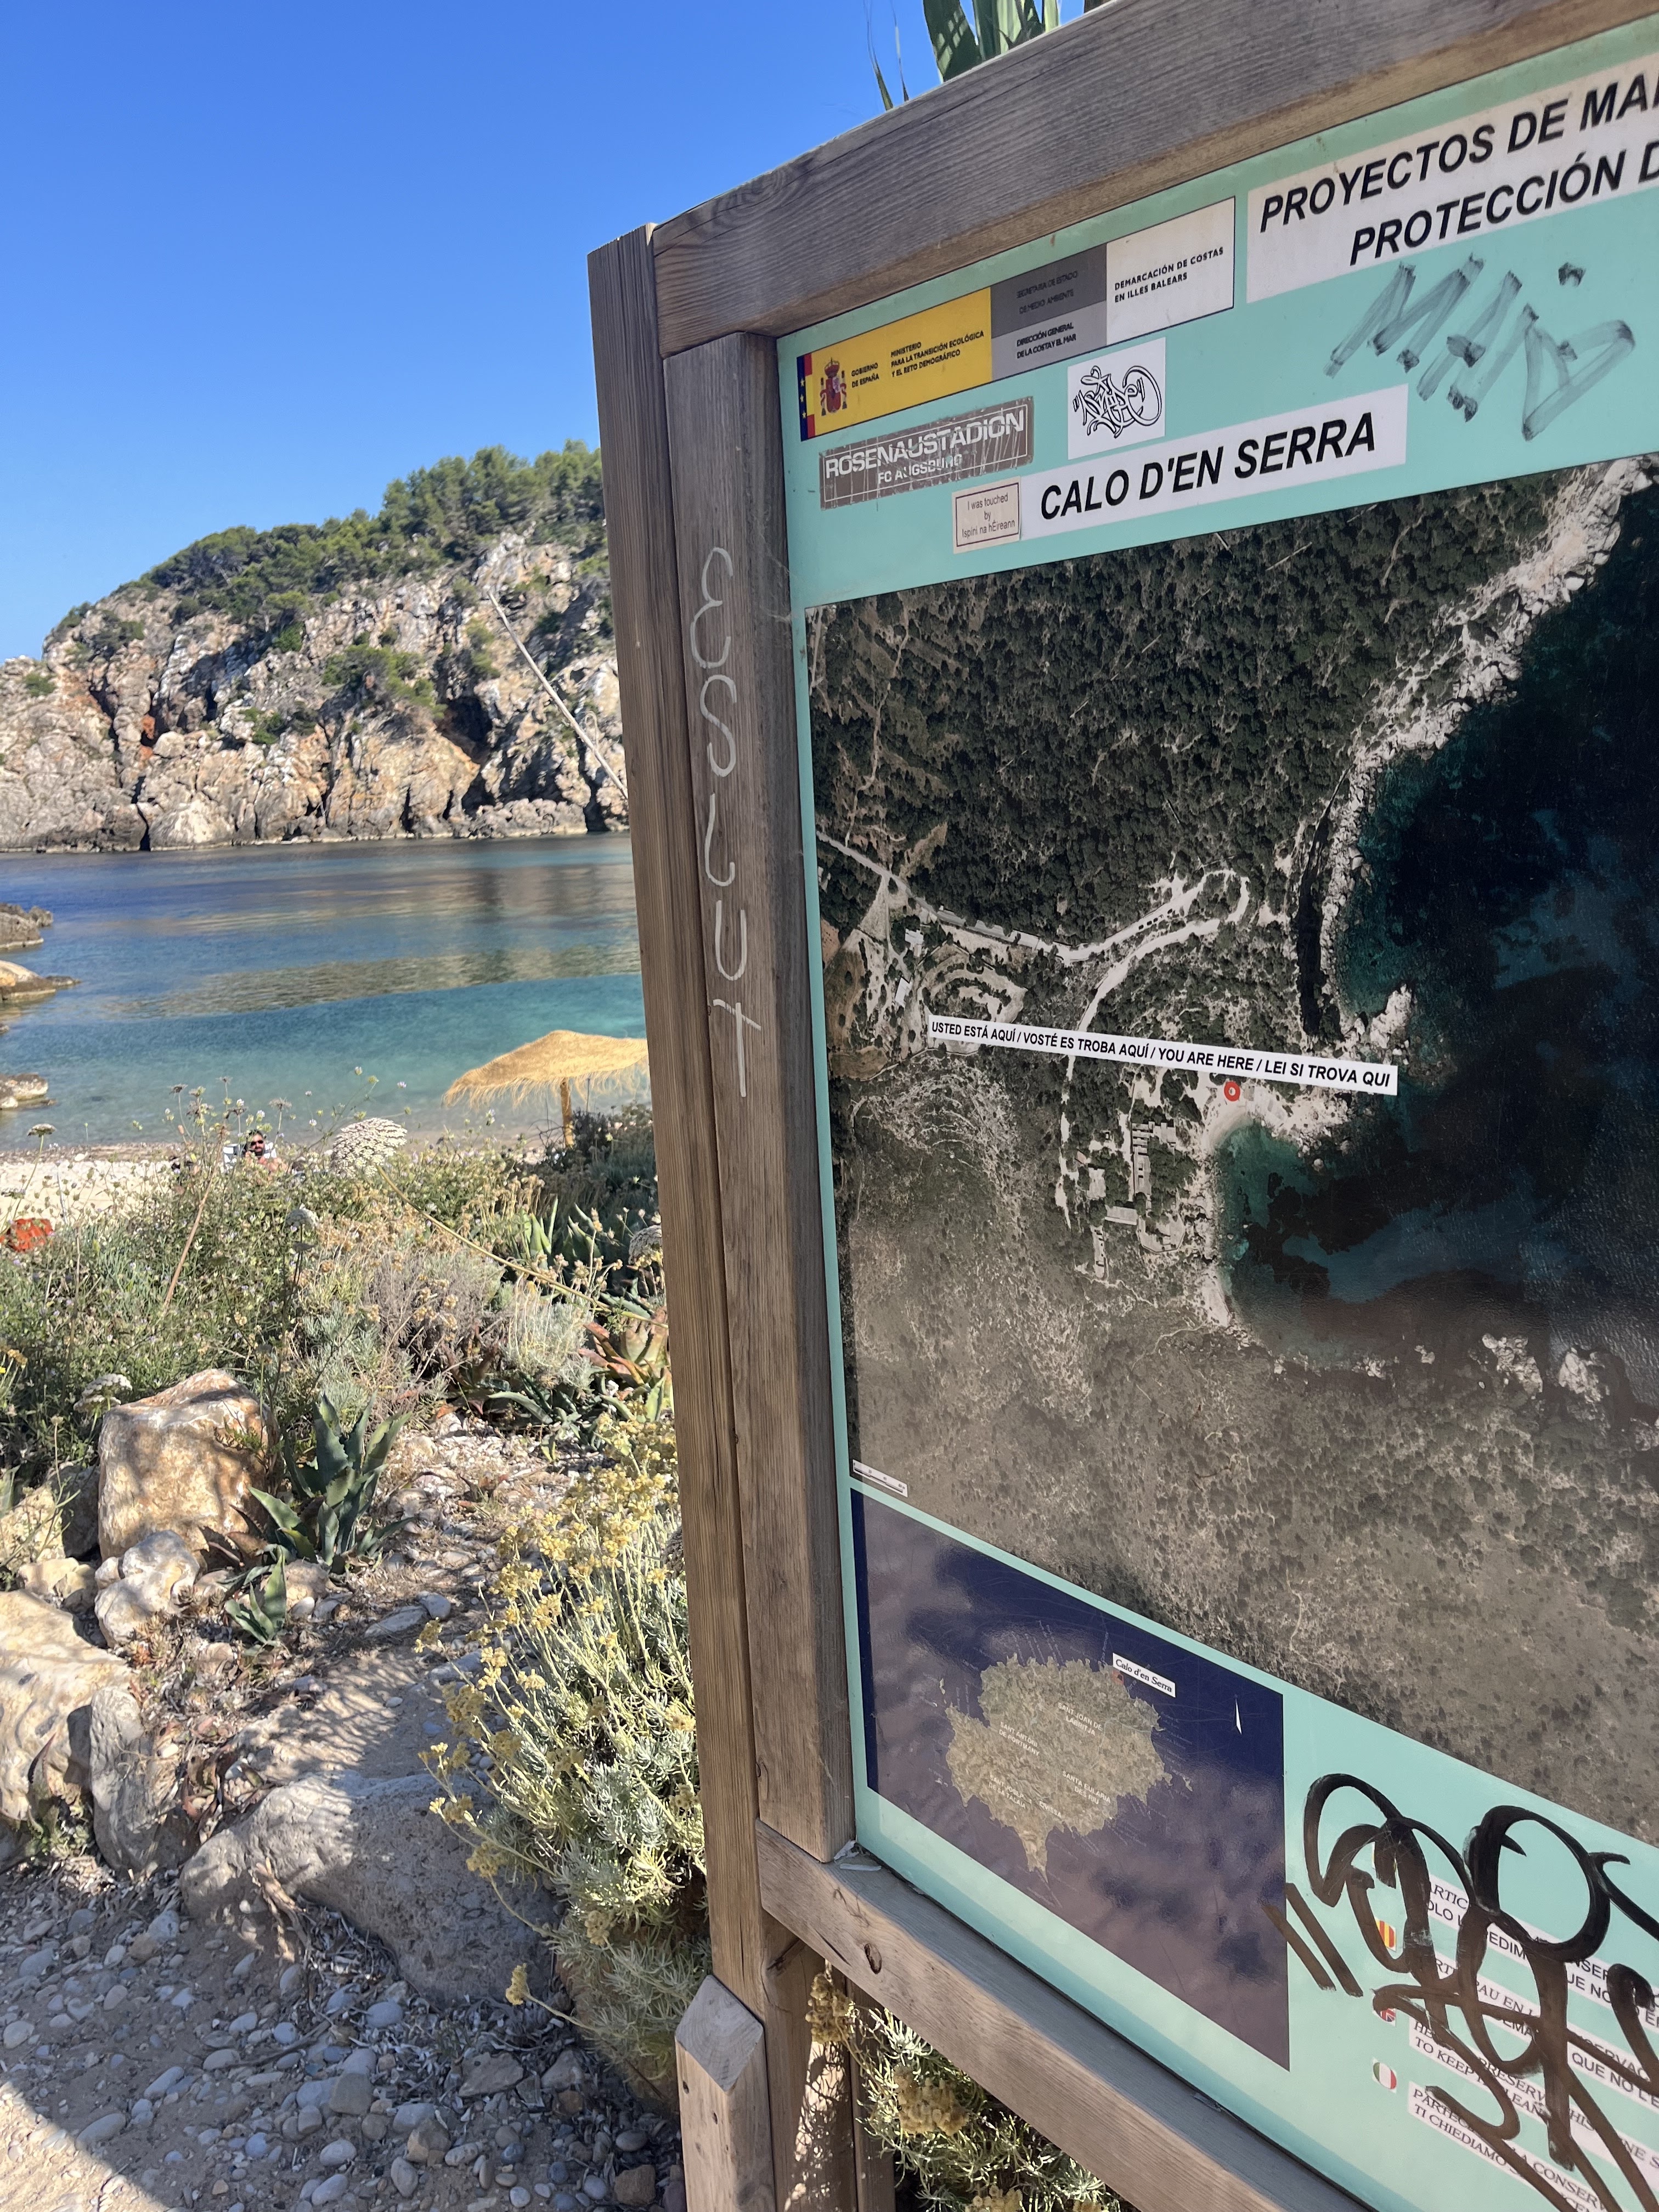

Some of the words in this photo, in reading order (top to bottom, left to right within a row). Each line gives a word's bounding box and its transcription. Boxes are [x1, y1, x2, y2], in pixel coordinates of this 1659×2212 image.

[1260, 124, 1494, 233] PROYECTOS
[1507, 98, 1568, 153] DE
[1349, 150, 1627, 266] PROTECCIÓN
[1115, 263, 1174, 291] DEMARCACIÓN
[1177, 259, 1188, 270] DE
[1190, 246, 1224, 265] COSTAS
[1115, 292, 1125, 303] EN
[1127, 284, 1149, 299] ILLES
[1151, 272, 1188, 291] BALEARS
[1017, 330, 1047, 347] DIRECCIÓN
[1047, 322, 1074, 337] GENERAL
[1017, 351, 1025, 359] DE
[1025, 347, 1032, 356] LA
[1032, 341, 1052, 354] COSTA
[1056, 338, 1063, 346] EL
[1063, 334, 1077, 344] MAR
[890, 341, 922, 358] MINISTERIO
[891, 358, 905, 368] PARA
[913, 341, 949, 362] TRANSICIÓN
[949, 330, 984, 348] ECOLÓGICA
[896, 368, 903, 377] EL
[904, 363, 918, 374] RETO
[919, 348, 961, 369] DEMOGRÁFICO
[851, 362, 878, 377] GOBIERNO
[860, 373, 879, 385] ESPAÑA
[825, 409, 1024, 479] ROSENAUSTADION
[878, 470, 892, 484] FC
[1040, 469, 1129, 521] CALO
[1139, 445, 1224, 500] D'EN
[1234, 412, 1375, 479] SERRA
[971, 500, 983, 510] was
[984, 492, 1008, 507] touched
[979, 526, 987, 534] na
[984, 511, 991, 522] by
[932, 1021, 962, 1035] USTED
[964, 1024, 989, 1039] ESTÁ
[991, 1028, 1015, 1043] AQUÍ
[1024, 1032, 1058, 1047] VOSTÉ
[1060, 1036, 1074, 1049] ES
[1077, 1038, 1116, 1054] TROBA
[1119, 1042, 1149, 1059] AQUÍ
[1159, 1047, 1184, 1063] YOU
[1187, 1051, 1214, 1066] ARE
[1217, 1055, 1255, 1071] HERE
[1265, 1059, 1286, 1075] LEI
[1290, 1063, 1304, 1077] SI
[1308, 1064, 1358, 1084] TROVA
[1362, 1071, 1391, 1087] QUI
[1115, 1659, 1132, 1672] Calo
[1134, 1668, 1149, 1681] d'en
[1151, 1676, 1172, 1692] Serra
[1057, 1702, 1075, 1716] SANT
[1075, 1712, 1093, 1726] JOAN
[1093, 1721, 1103, 1731] DE
[1065, 1715, 1096, 1736] LABRITJA
[998, 1729, 1007, 1739] DE
[1007, 1735, 1040, 1756] PORTMANY
[1000, 1721, 1015, 1734] SANT
[1016, 1731, 1039, 1748] ANTONI
[988, 1782, 997, 1791] DE
[997, 1787, 1006, 1796] SA
[990, 1775, 1005, 1787] SANT
[1005, 1785, 1025, 1799] JOSEP
[1062, 1770, 1083, 1787] SANTA
[1039, 1800, 1062, 1818] EIVISSA
[1074, 1786, 1087, 1798] DES
[1088, 1794, 1099, 1805] RIU
[1415, 2036, 1434, 2053] TO
[1437, 2049, 1475, 2075] KEEP
[1572, 2052, 1605, 2079] QUE
[1610, 2071, 1633, 2092] NO
[1414, 2103, 1426, 2119] TI
[1429, 2114, 1507, 2166] CHIEDIAMO
